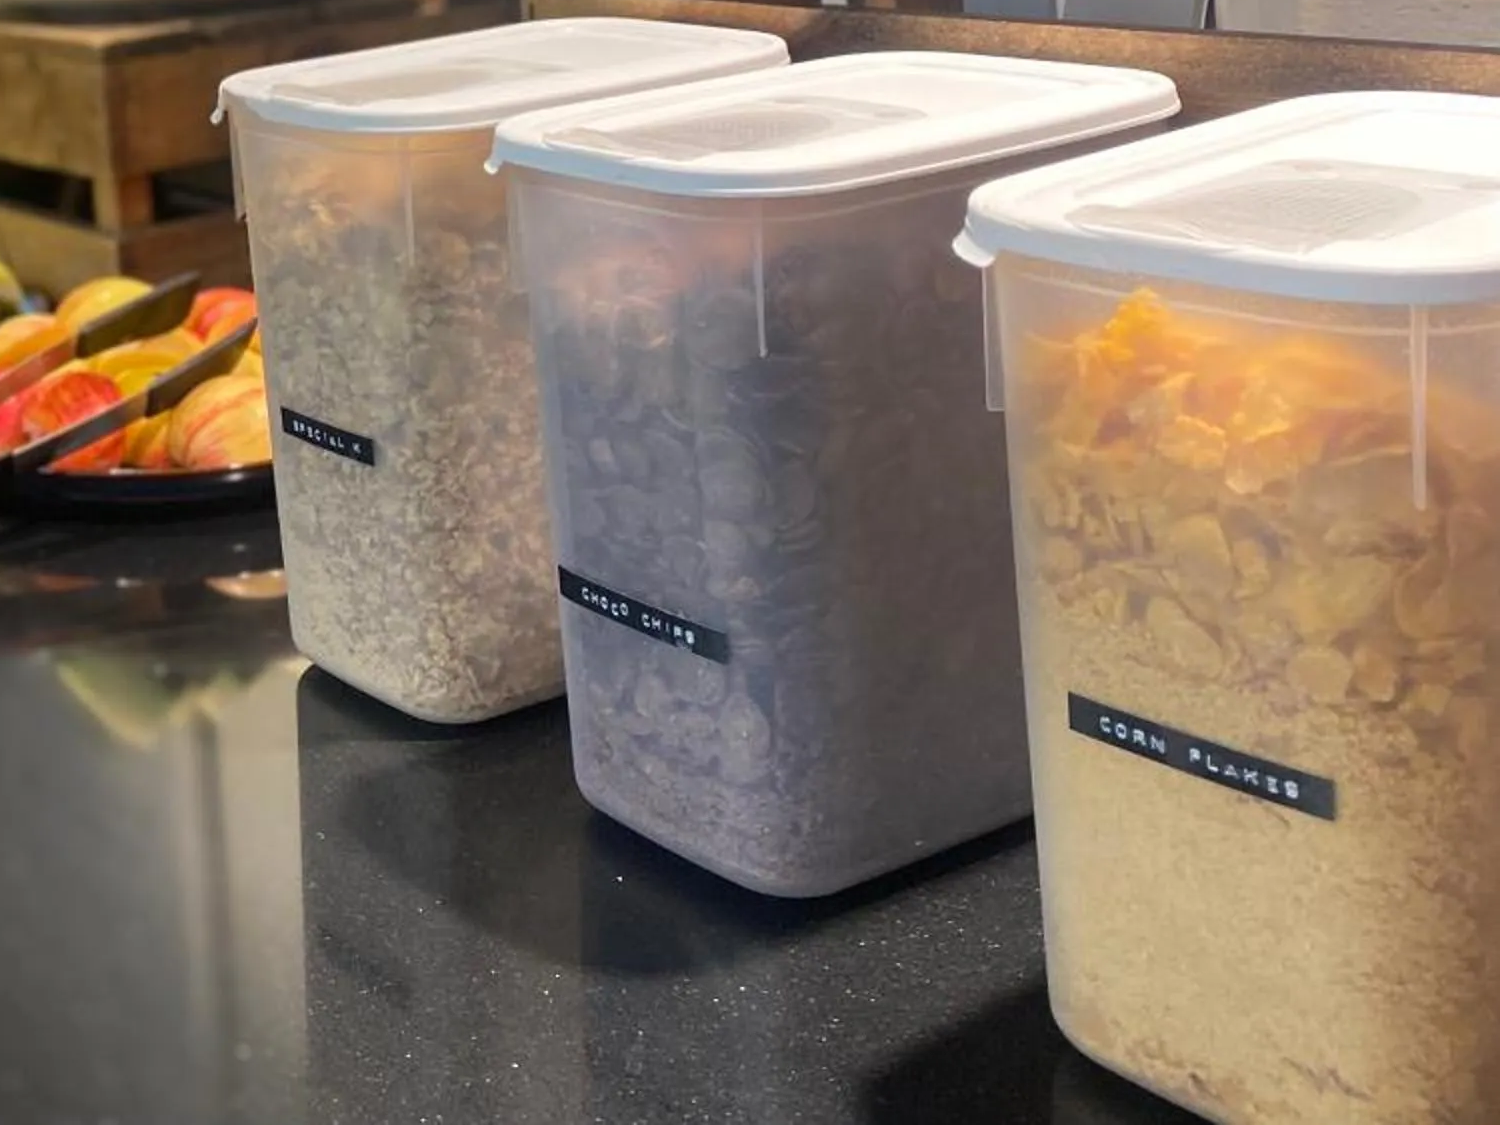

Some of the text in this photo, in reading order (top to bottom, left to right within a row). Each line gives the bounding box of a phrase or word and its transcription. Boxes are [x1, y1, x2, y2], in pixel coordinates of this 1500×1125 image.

[292, 419, 345, 449] SPECIAL
[581, 586, 696, 645] CHOCO CHIPS
[1099, 716, 1166, 755] CORN
